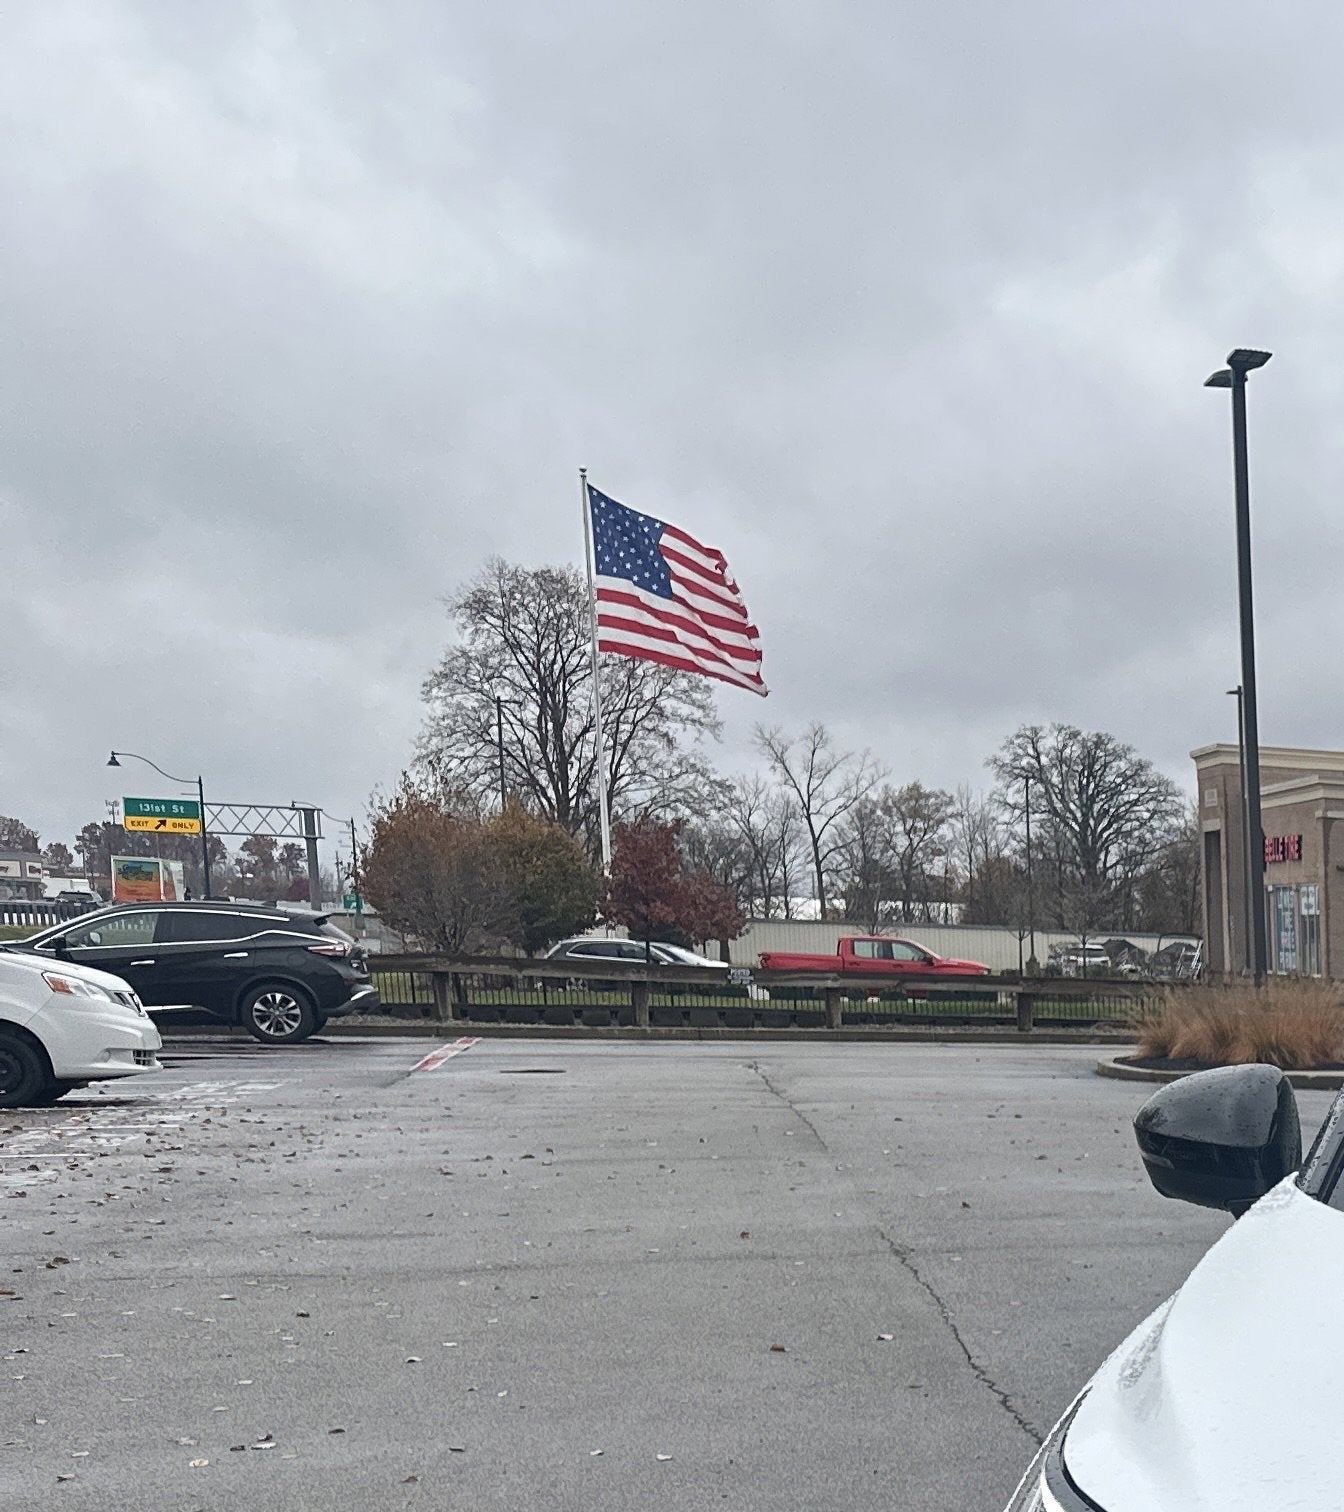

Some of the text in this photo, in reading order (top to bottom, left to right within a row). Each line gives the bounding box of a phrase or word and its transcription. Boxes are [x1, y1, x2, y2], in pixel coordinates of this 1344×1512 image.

[139, 803, 185, 814] 131st St
[172, 822, 195, 830] ONLY
